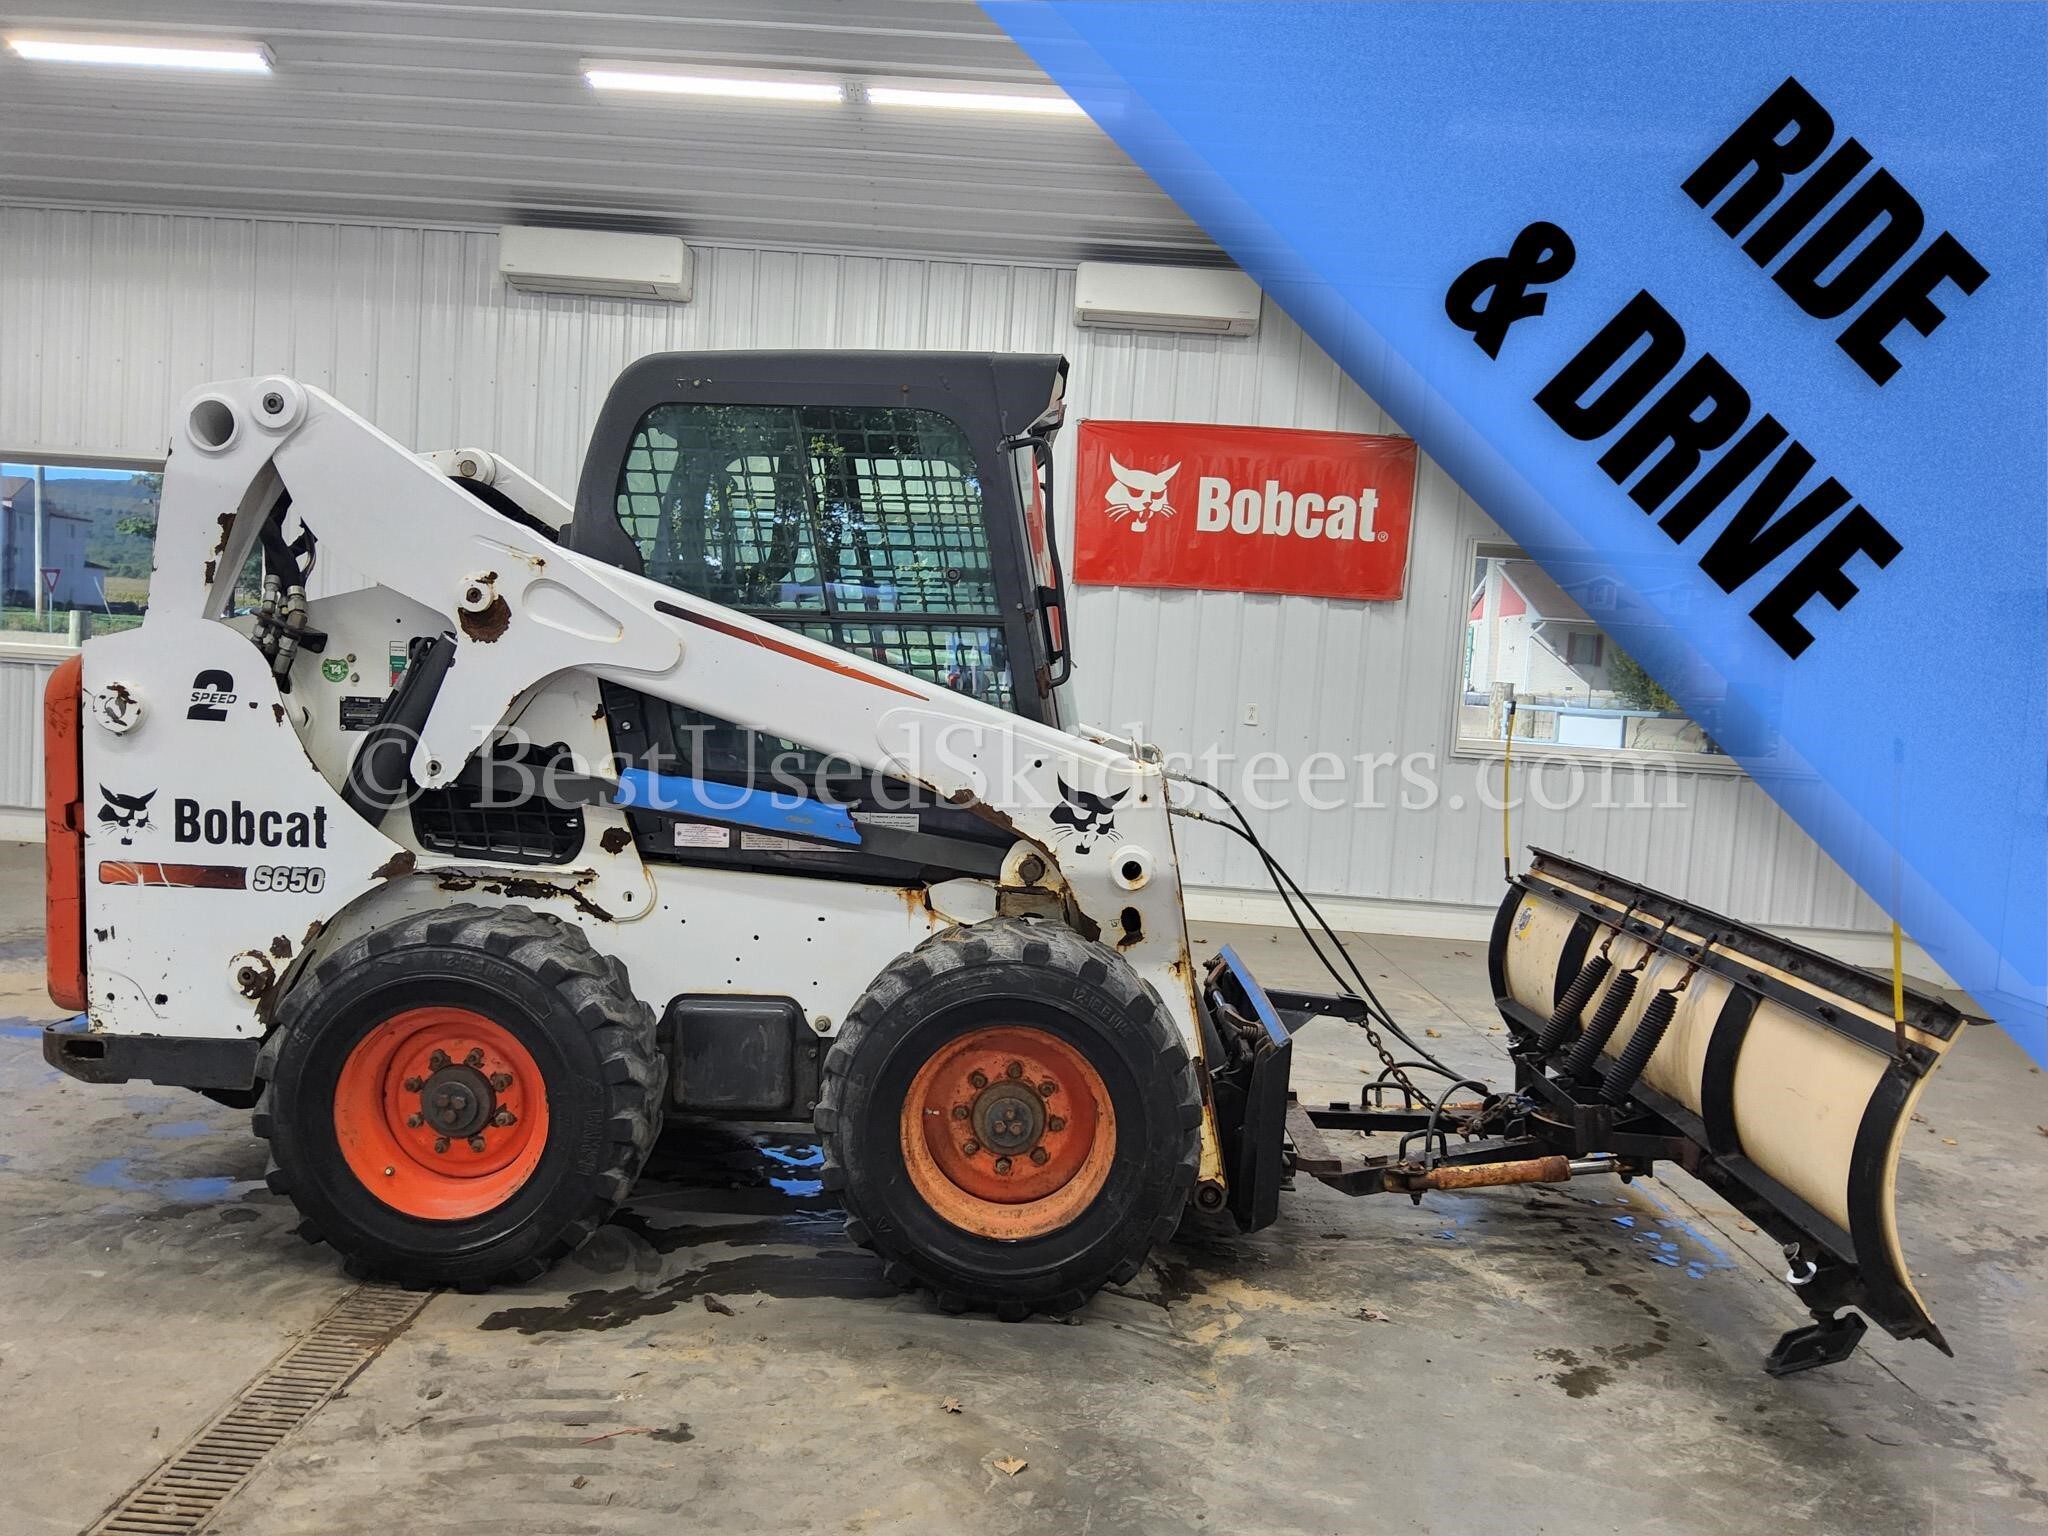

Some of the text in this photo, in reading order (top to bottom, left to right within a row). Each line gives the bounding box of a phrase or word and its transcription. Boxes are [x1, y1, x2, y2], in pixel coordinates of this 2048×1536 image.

[186, 669, 234, 722] 2
[190, 692, 238, 704] SPEED
[174, 798, 328, 849] Bobcat
[252, 864, 326, 894] S650
